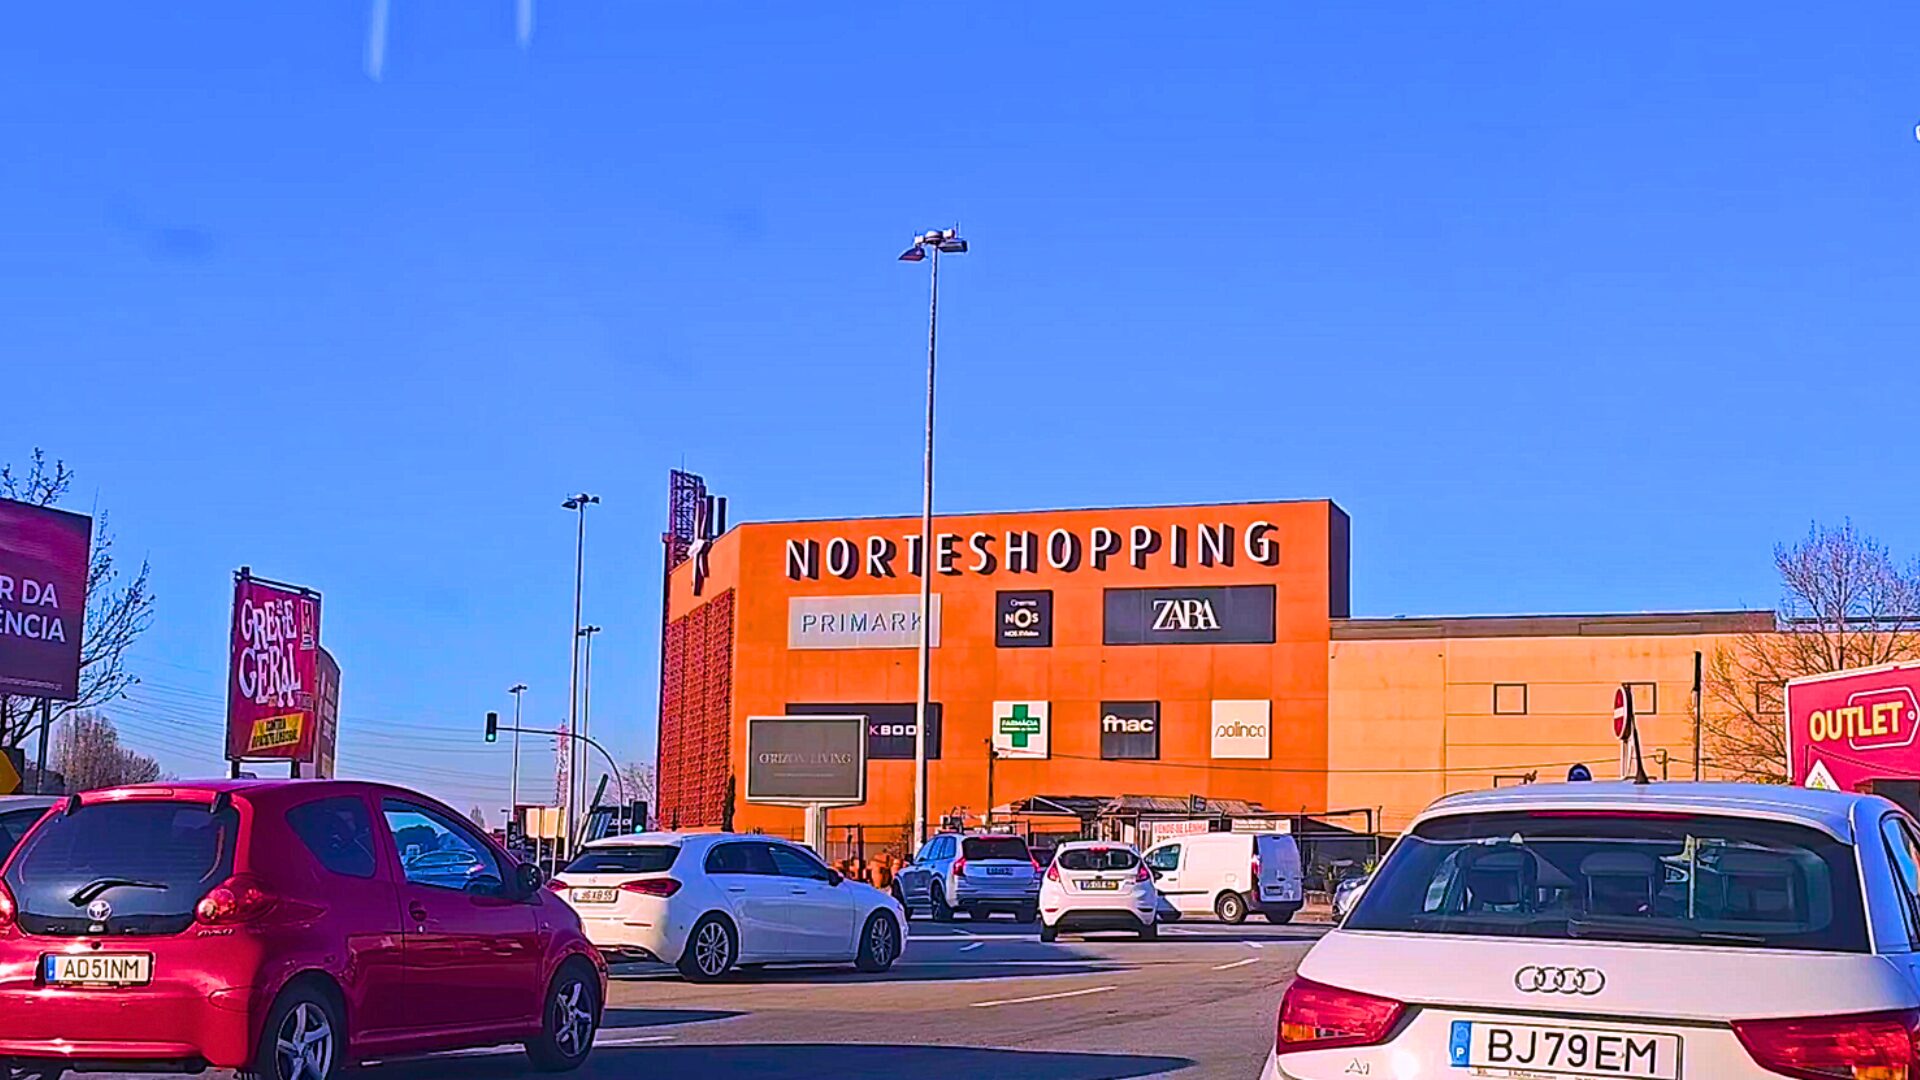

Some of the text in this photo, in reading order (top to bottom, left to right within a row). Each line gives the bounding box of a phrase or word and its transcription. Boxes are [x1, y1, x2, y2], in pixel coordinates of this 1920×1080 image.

[786, 520, 1279, 580] NORTESHOPPING
[22, 579, 58, 609] DA
[1152, 599, 1221, 630] ZARA
[241, 598, 297, 655] GREVE
[1004, 608, 1039, 628] NOS
[238, 642, 302, 708] GERAL
[1102, 715, 1154, 732] fnac
[1809, 701, 1904, 742] OUTLET
[1487, 1028, 1658, 1075] BJ79EM
